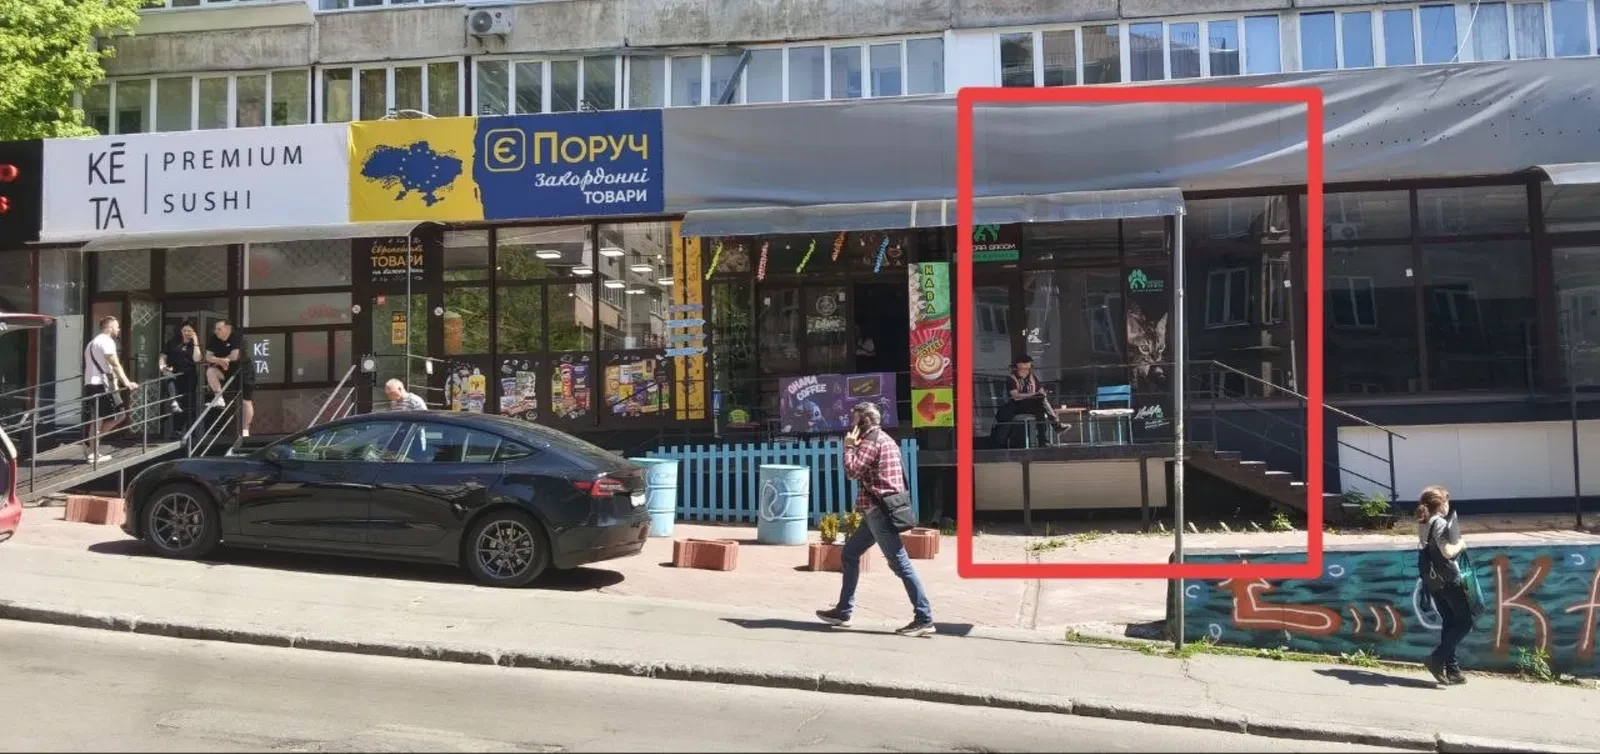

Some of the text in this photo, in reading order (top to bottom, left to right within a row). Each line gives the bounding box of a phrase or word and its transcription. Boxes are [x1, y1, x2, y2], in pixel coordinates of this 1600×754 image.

[163, 145, 303, 171] PREMIUM
[163, 190, 251, 213] SUSHI
[583, 189, 647, 204] ТОВАРИ
[88, 197, 125, 230] TA
[788, 375, 818, 394] OHANA
[796, 384, 827, 400] COFFEE
